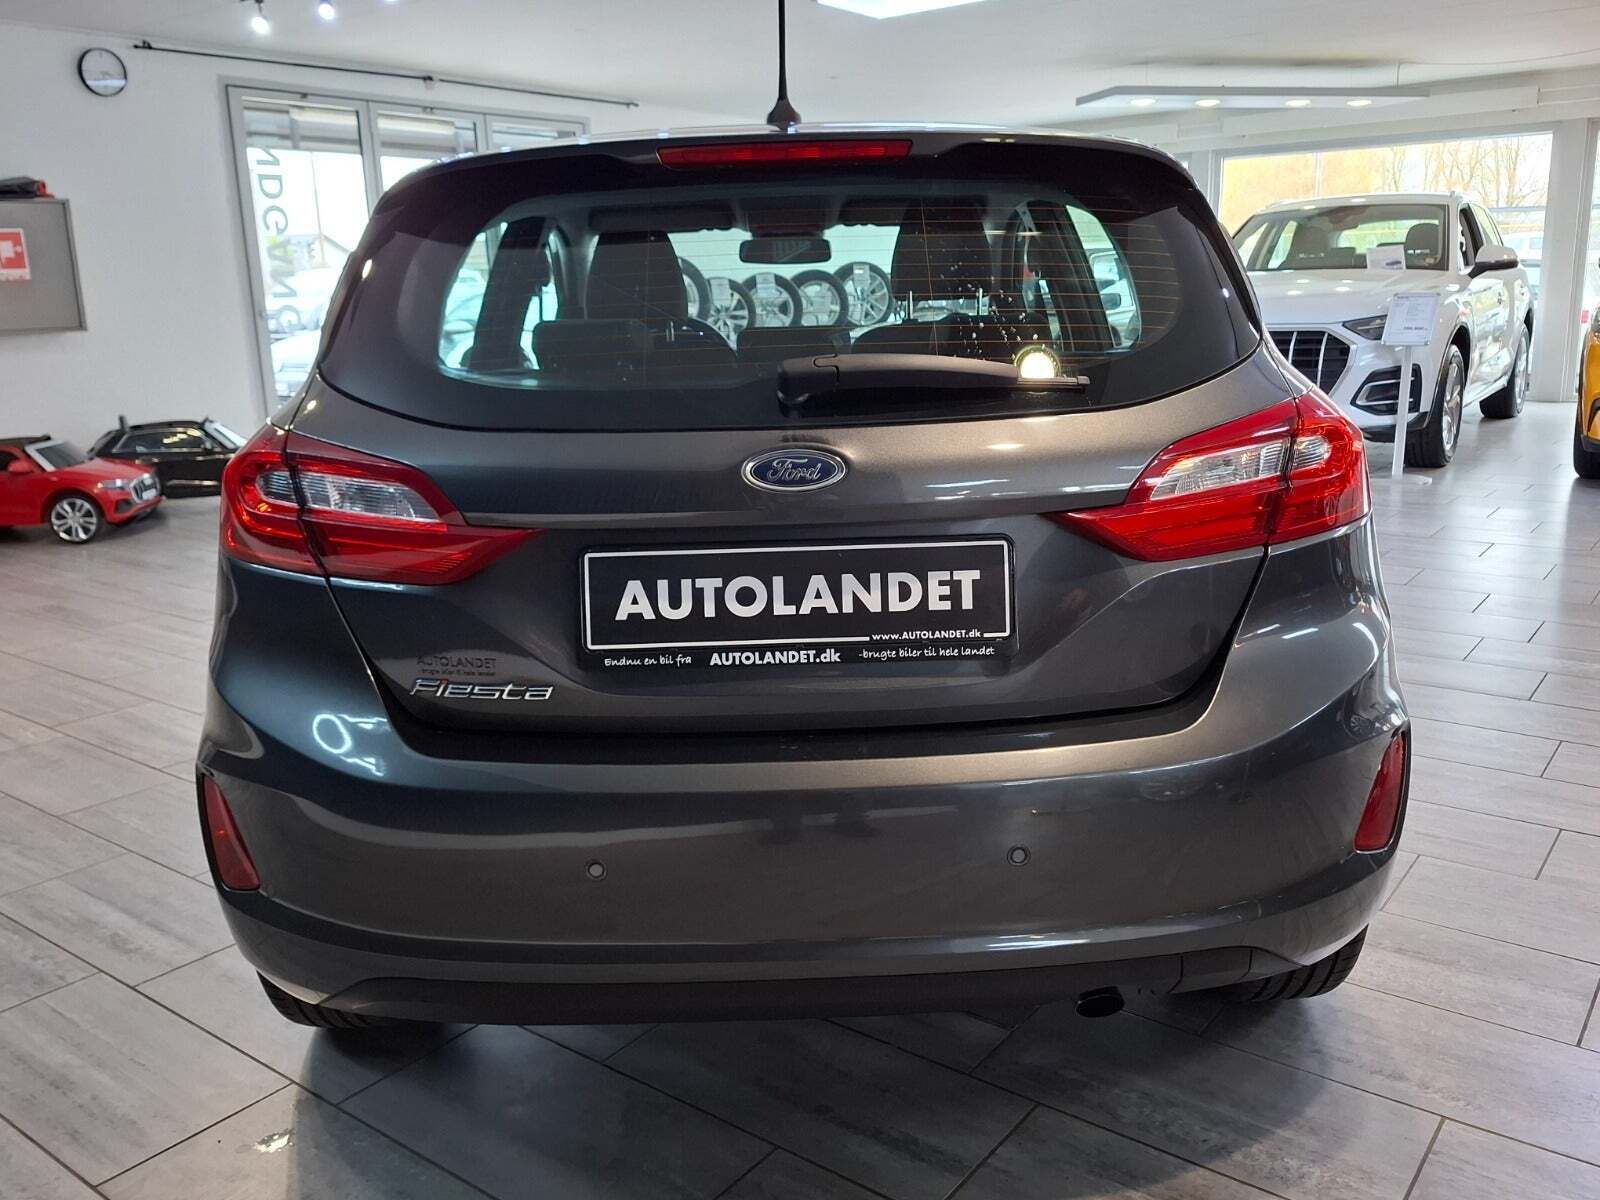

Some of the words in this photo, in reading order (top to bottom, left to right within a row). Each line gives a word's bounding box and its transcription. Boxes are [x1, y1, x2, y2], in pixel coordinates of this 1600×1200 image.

[767, 458, 822, 481] Ford
[615, 569, 981, 621] AUTOLANDET
[872, 629, 981, 641] www.AUTOLANDET.dk
[709, 649, 841, 666] AUTOLANDET.dk
[898, 647, 922, 658] biler
[923, 646, 937, 657] til
[939, 646, 959, 657] hele
[961, 645, 995, 656] landet
[416, 655, 497, 669] AUTOLANDET
[604, 657, 641, 666] Endnu
[644, 657, 657, 665] en
[659, 655, 674, 665] bil
[675, 655, 692, 667] fra
[409, 678, 554, 700] Fiesta
